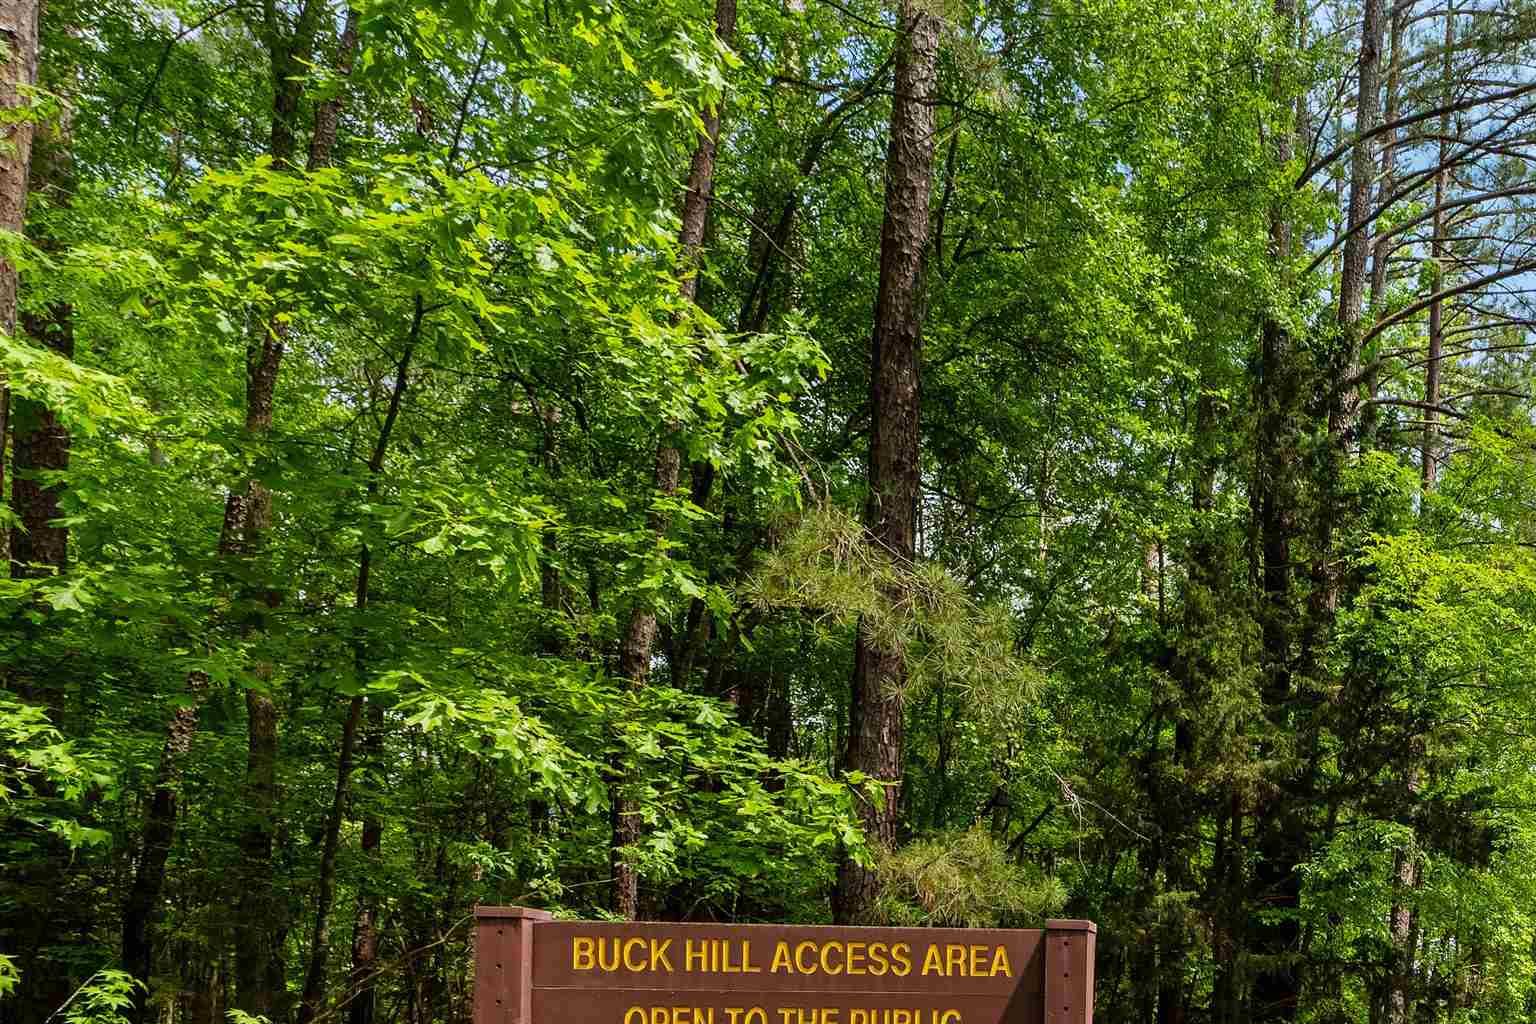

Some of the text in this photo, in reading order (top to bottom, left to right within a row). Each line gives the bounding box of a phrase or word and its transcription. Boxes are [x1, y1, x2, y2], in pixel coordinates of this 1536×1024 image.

[572, 936, 1014, 978] BUCK HILL ACCESS AREA
